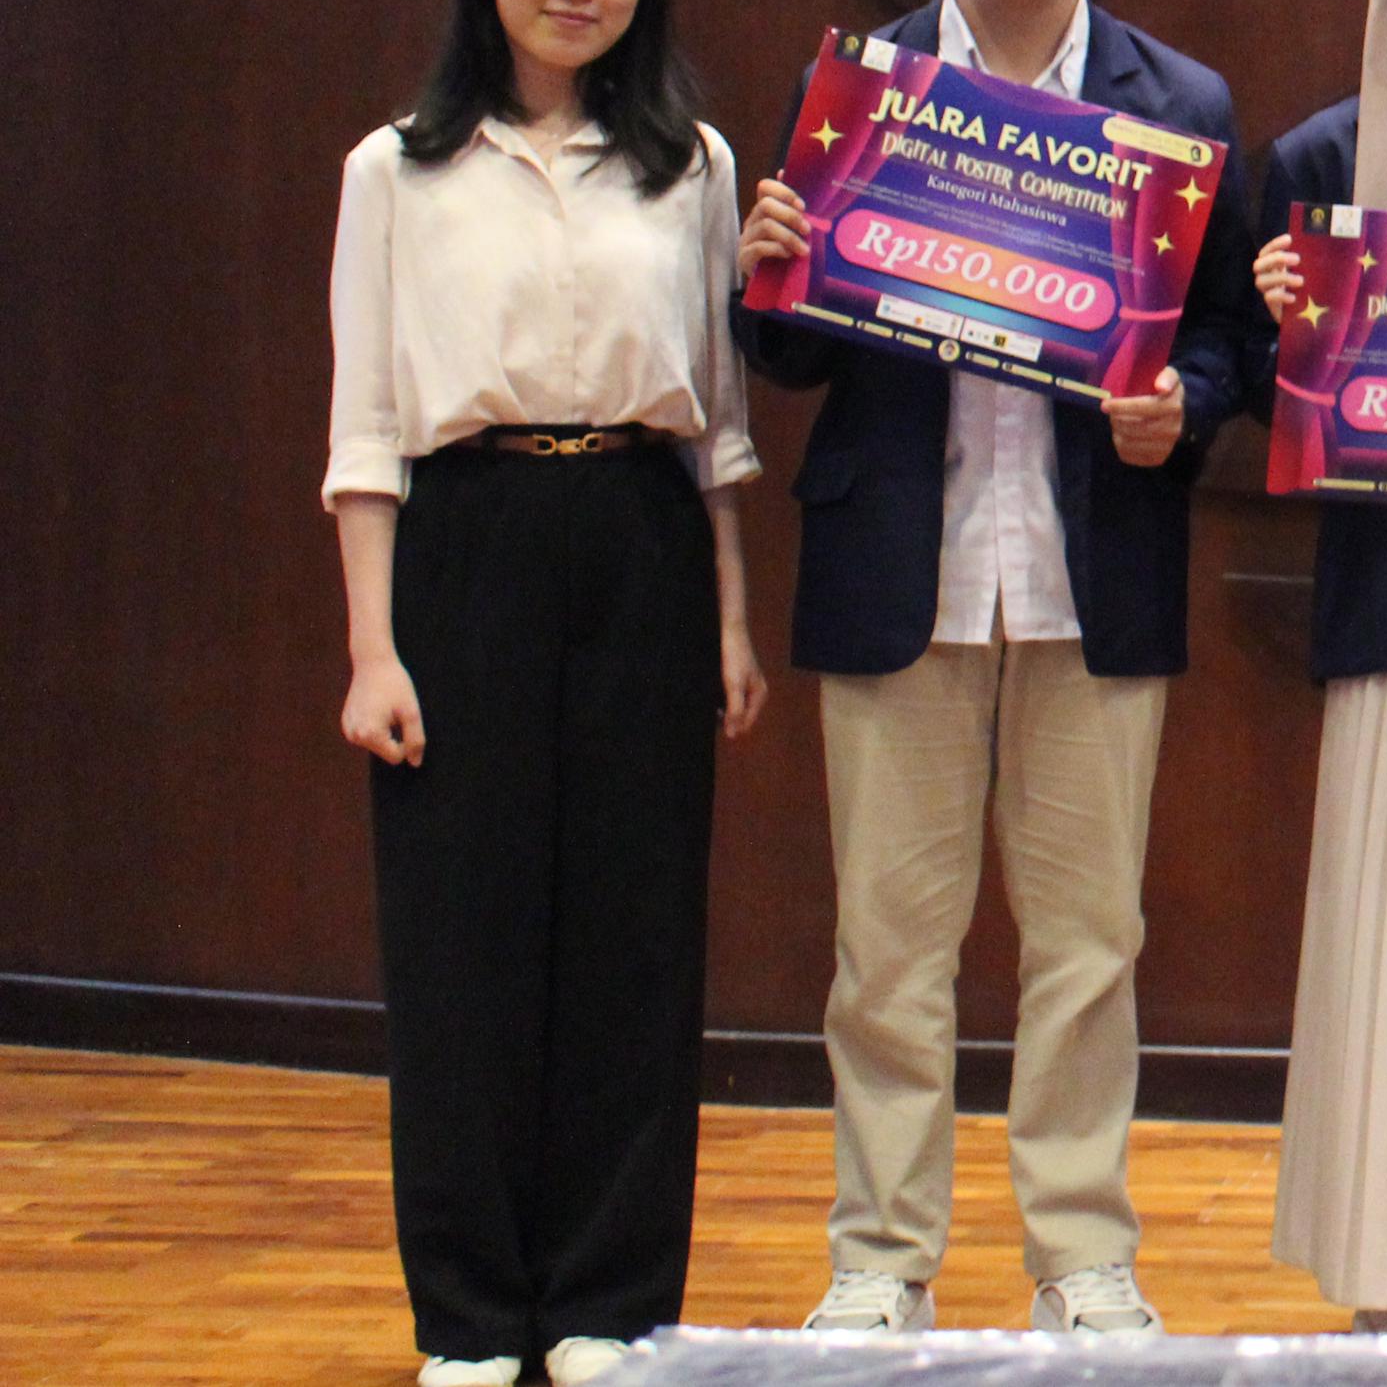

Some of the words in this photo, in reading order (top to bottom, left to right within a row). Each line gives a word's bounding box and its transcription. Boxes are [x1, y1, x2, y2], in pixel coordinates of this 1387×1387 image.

[869, 88, 986, 146] JUARA
[997, 124, 1152, 191] FAVORIT
[926, 174, 988, 205] Kategori
[989, 192, 1067, 228] Mahasiswa
[954, 153, 1012, 192] POSTER
[1020, 170, 1128, 219] COMPETITION
[856, 219, 1096, 313] Rp150.000
